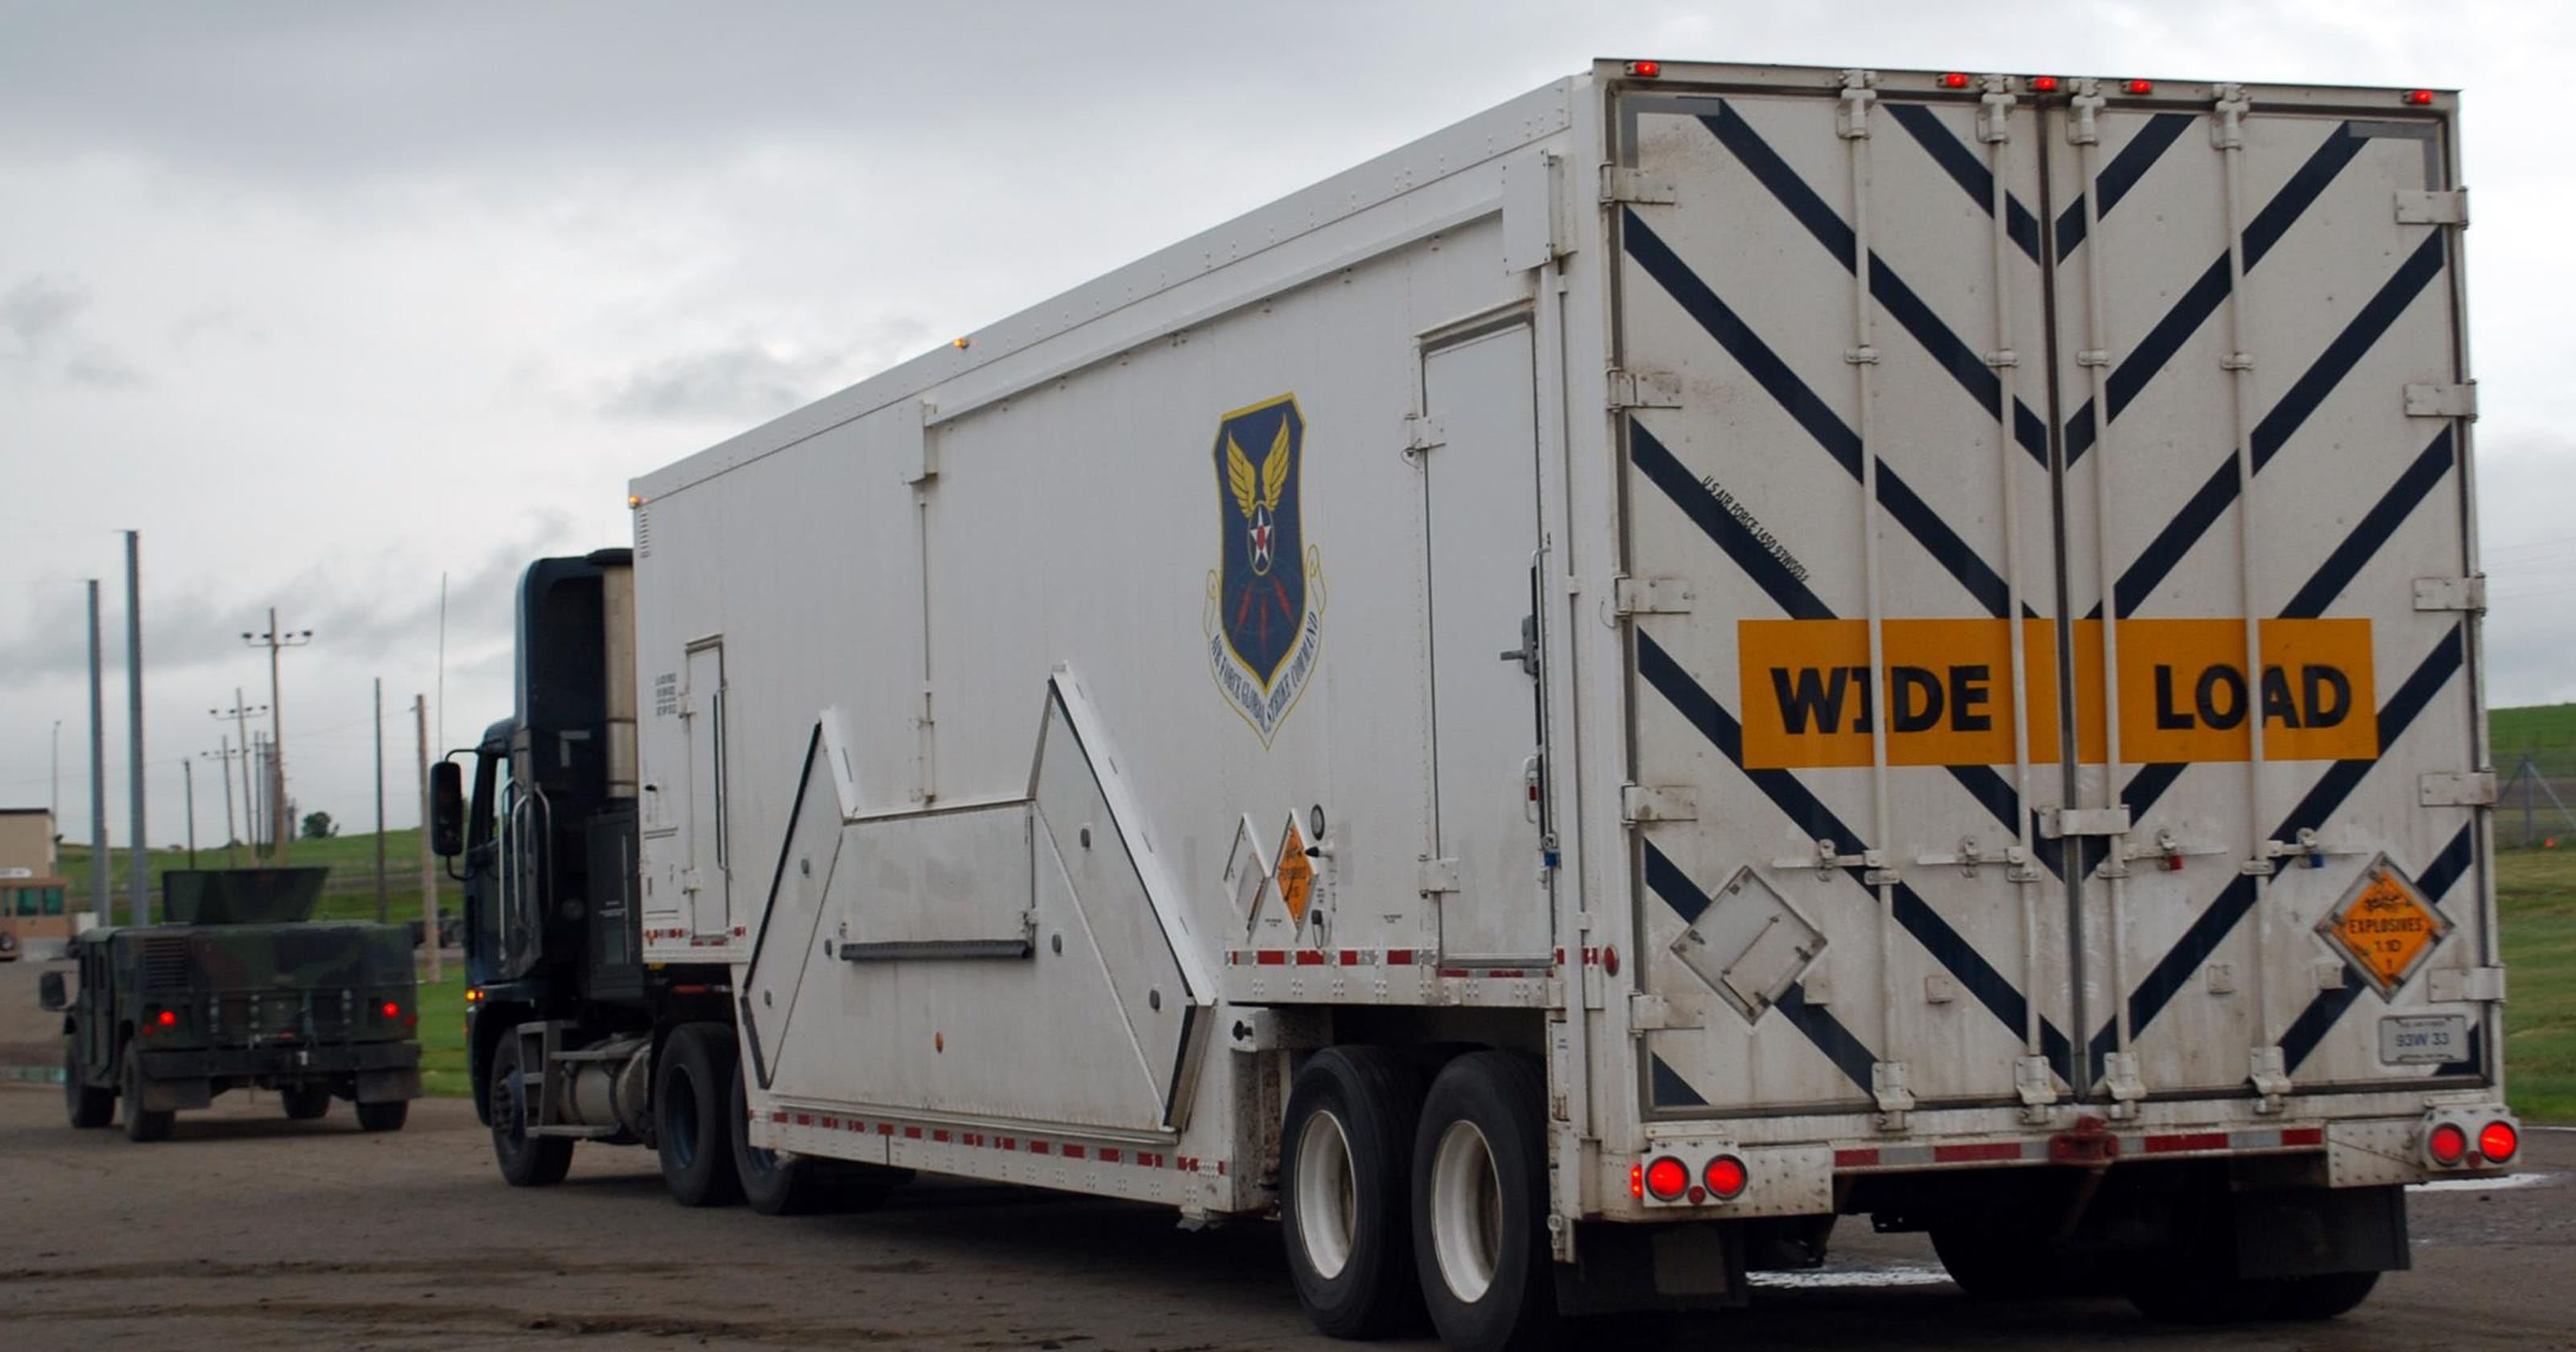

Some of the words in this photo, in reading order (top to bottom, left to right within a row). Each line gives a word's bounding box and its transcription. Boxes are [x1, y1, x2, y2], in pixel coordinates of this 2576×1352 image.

[1715, 489, 1734, 506] AIR
[1728, 503, 1759, 531] FORCE
[1769, 665, 1992, 734] WIDE
[2154, 663, 2351, 730] LOAD
[2349, 917, 2422, 934] EXPLOSIVES
